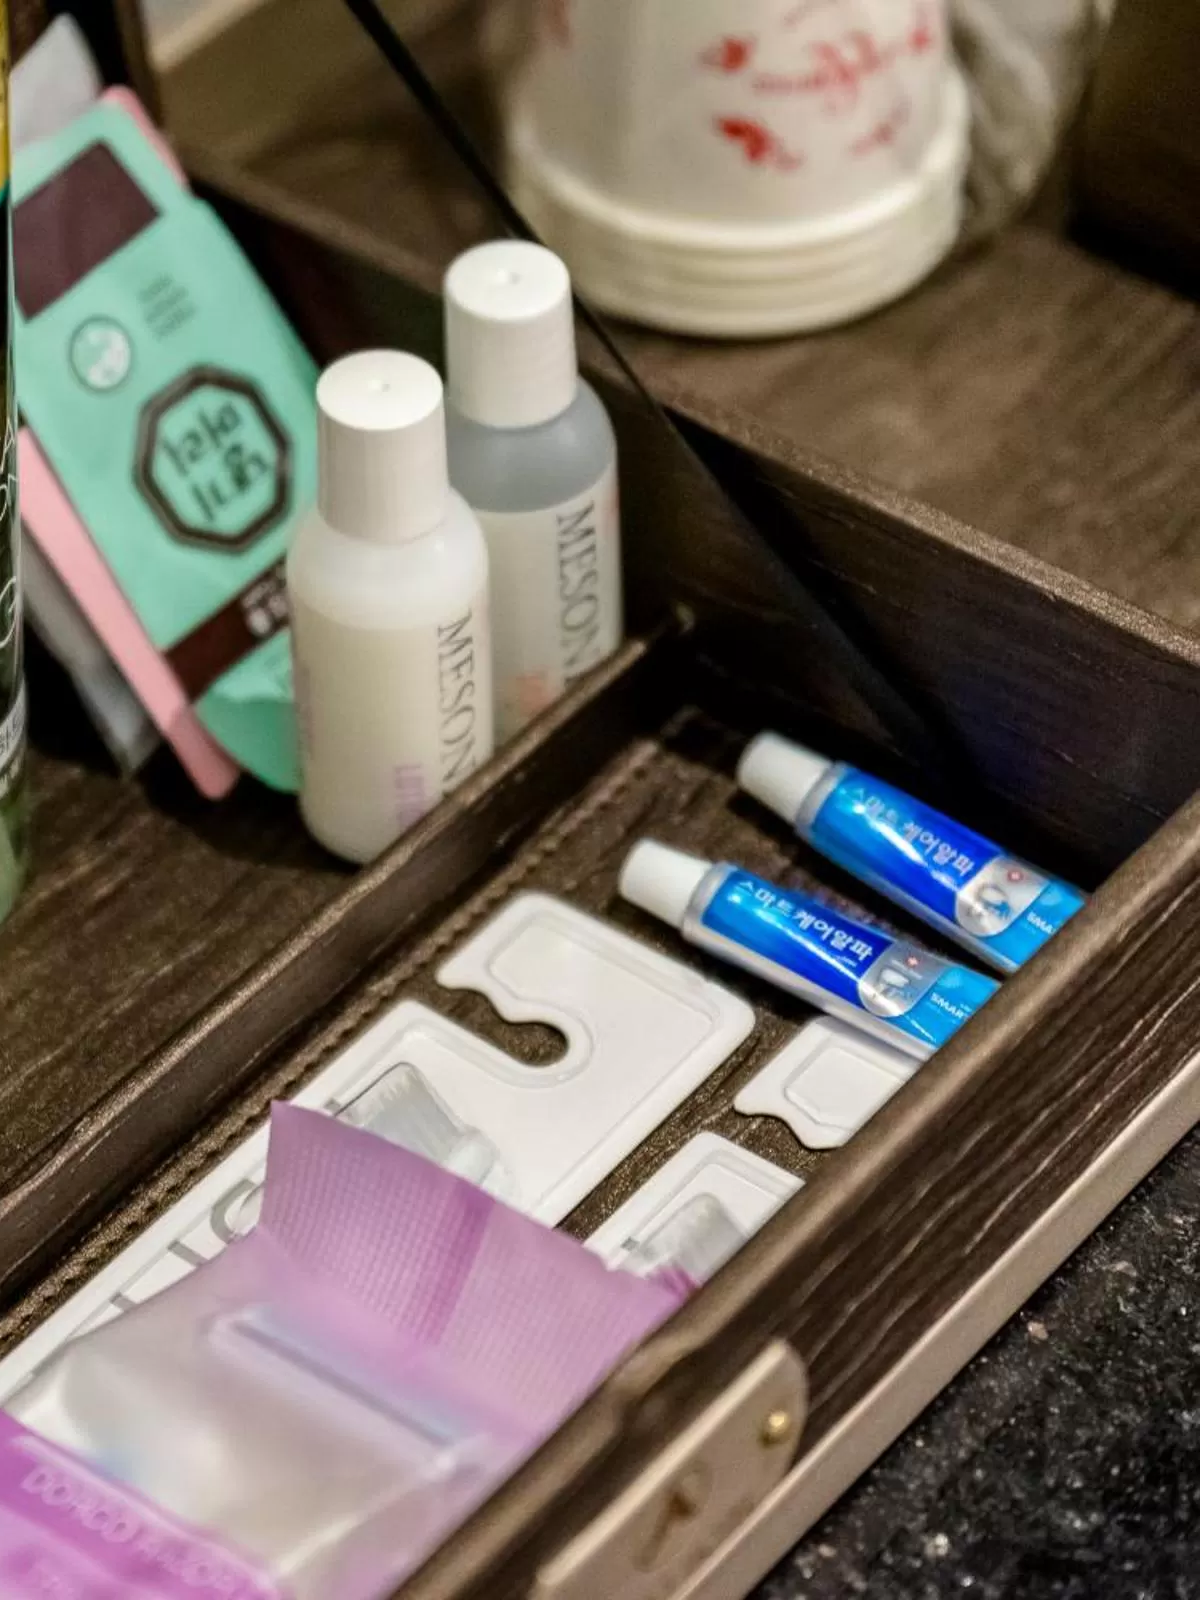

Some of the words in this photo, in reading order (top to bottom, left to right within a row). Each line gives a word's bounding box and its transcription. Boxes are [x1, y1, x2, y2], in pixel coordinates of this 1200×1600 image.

[557, 501, 601, 688] MESON
[437, 606, 477, 797] MESON
[1026, 911, 1056, 936] SMA
